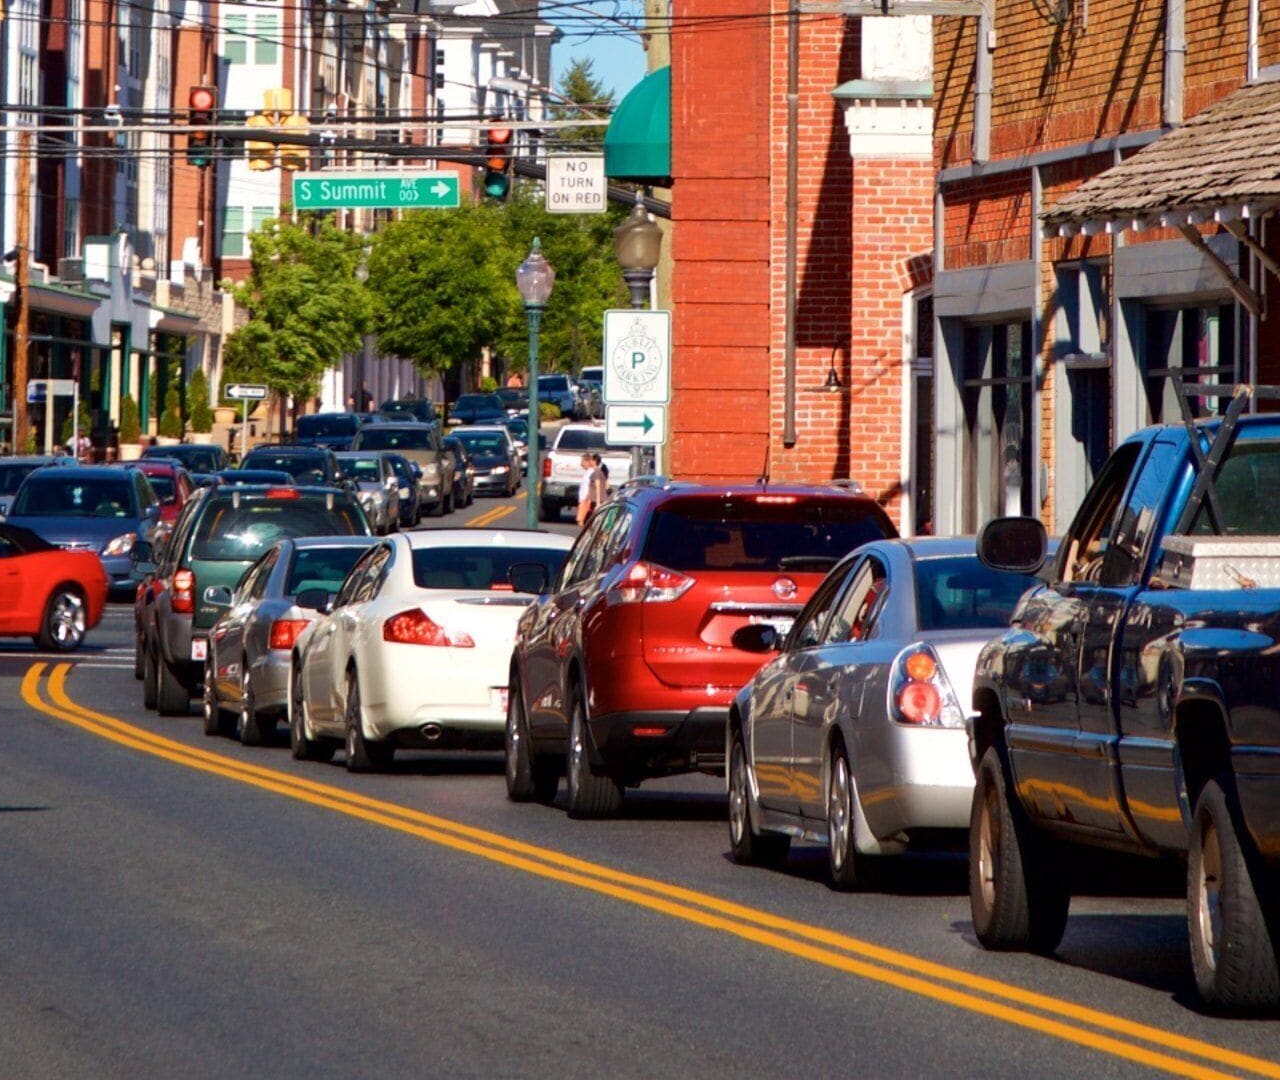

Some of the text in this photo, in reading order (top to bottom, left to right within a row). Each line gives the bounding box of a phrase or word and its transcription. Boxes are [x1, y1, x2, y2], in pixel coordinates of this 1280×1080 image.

[566, 161, 588, 172] NO
[399, 178, 419, 190] AVE
[560, 177, 594, 188] TURN
[300, 180, 387, 201] S Summit
[552, 192, 601, 204] ON RED
[631, 351, 646, 370] P
